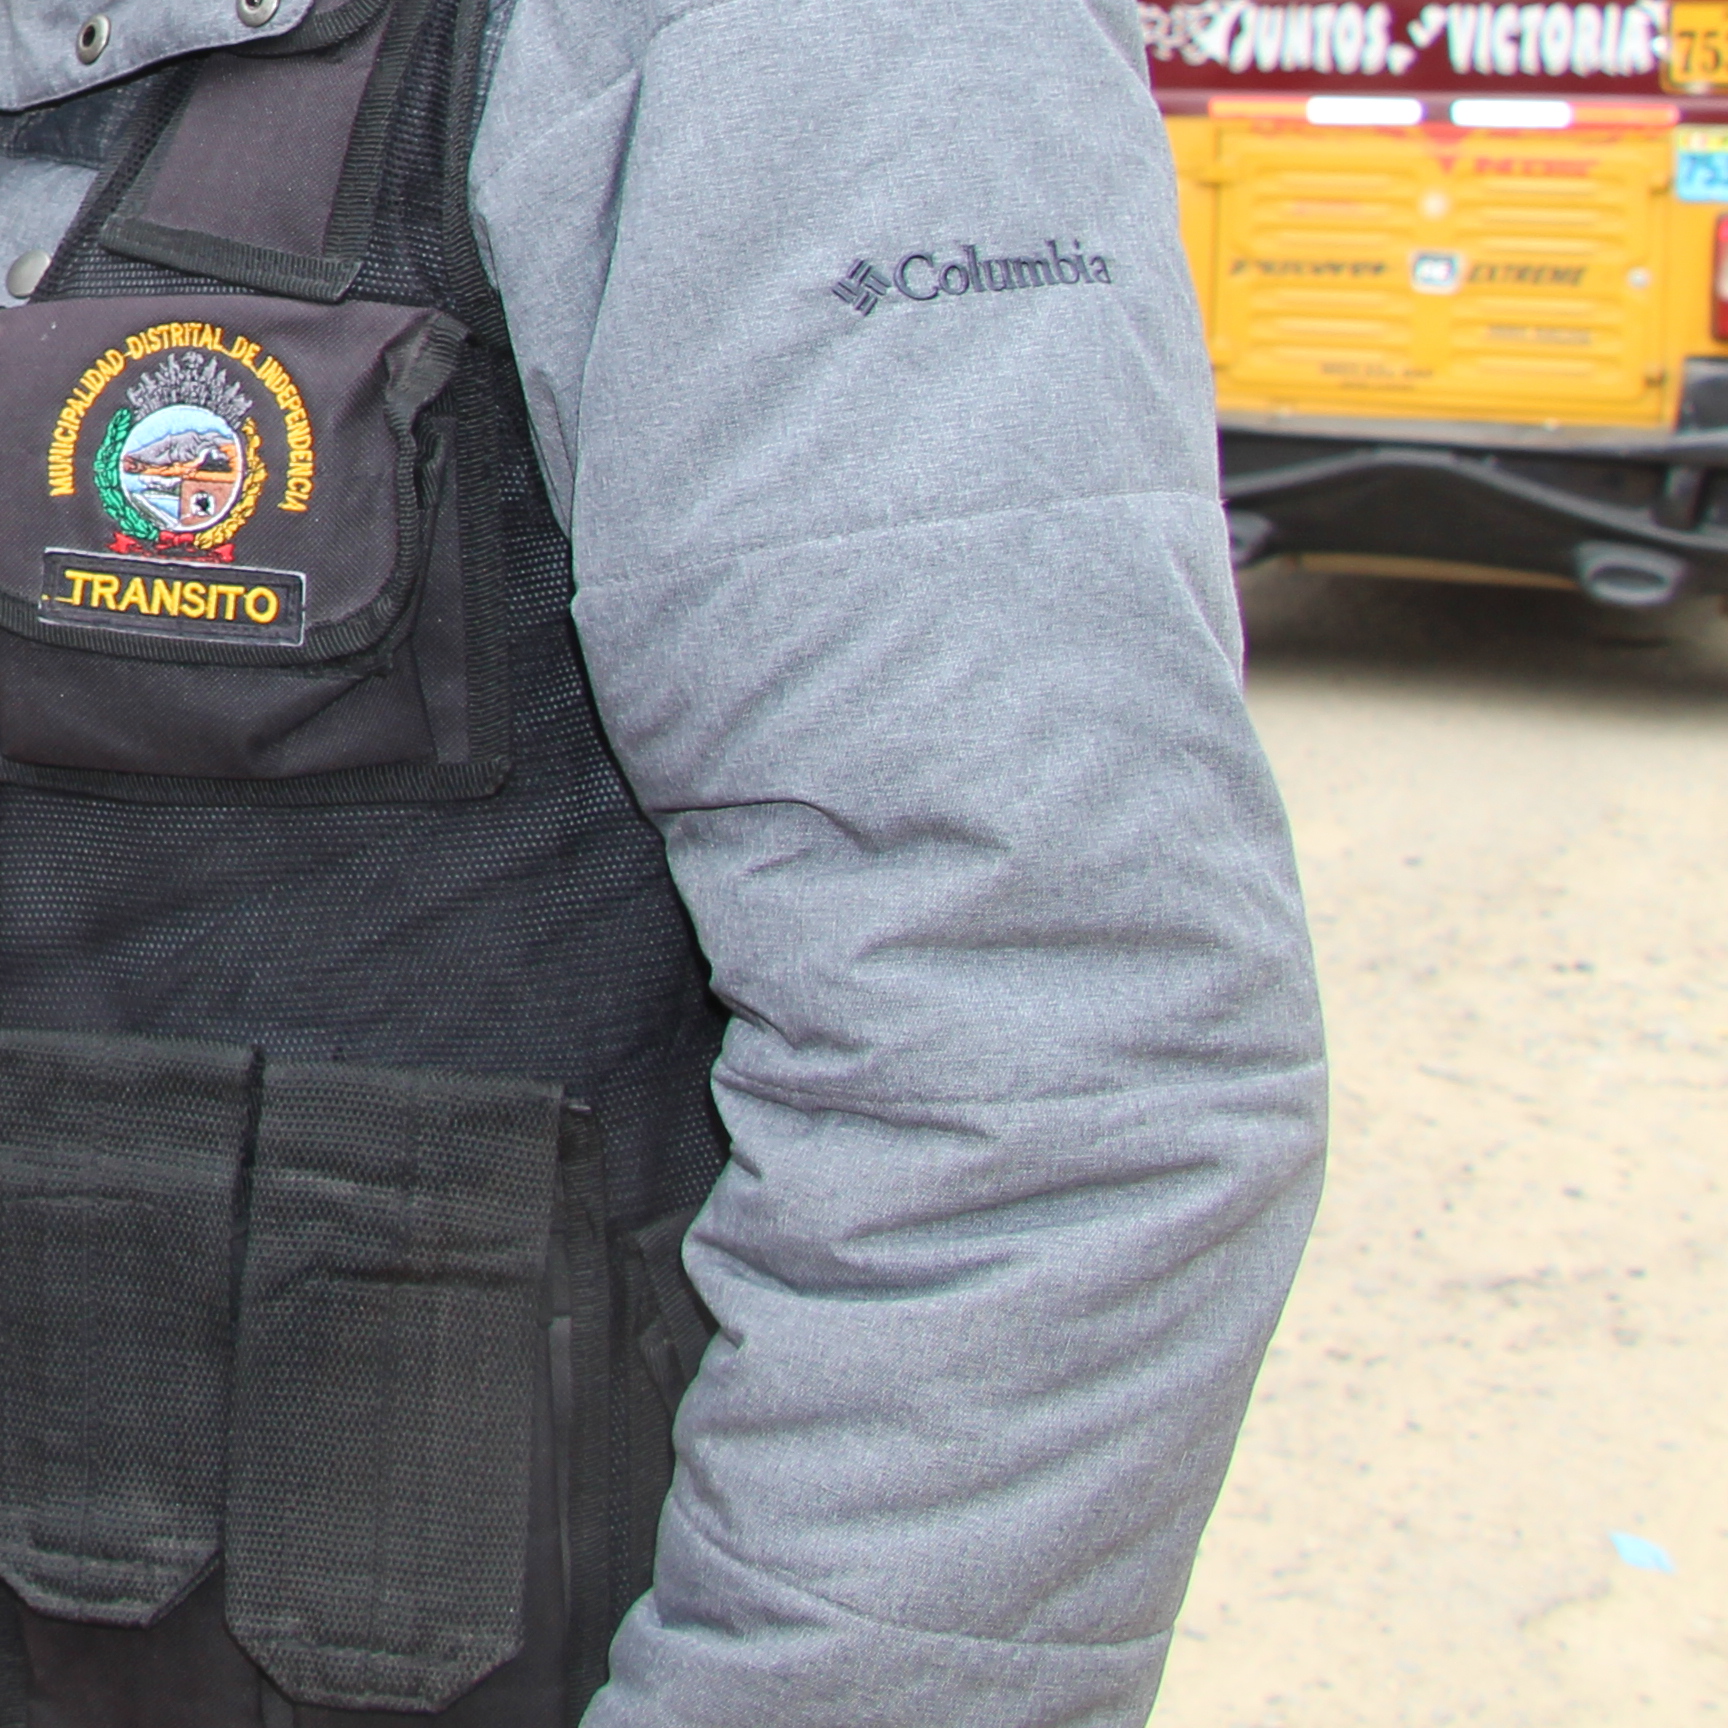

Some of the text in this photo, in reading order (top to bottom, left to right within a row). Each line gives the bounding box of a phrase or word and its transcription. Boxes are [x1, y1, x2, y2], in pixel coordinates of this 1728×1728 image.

[1446, 1, 1654, 76] VICTORIA
[1678, 30, 1728, 73] 75
[893, 238, 1113, 301] Columbia
[1468, 261, 1588, 286] EXTREME
[47, 322, 315, 512] MUNICIPALIDAD DISTRITAL DE INDEPENDENCIA
[63, 568, 280, 623] TRANSITO
